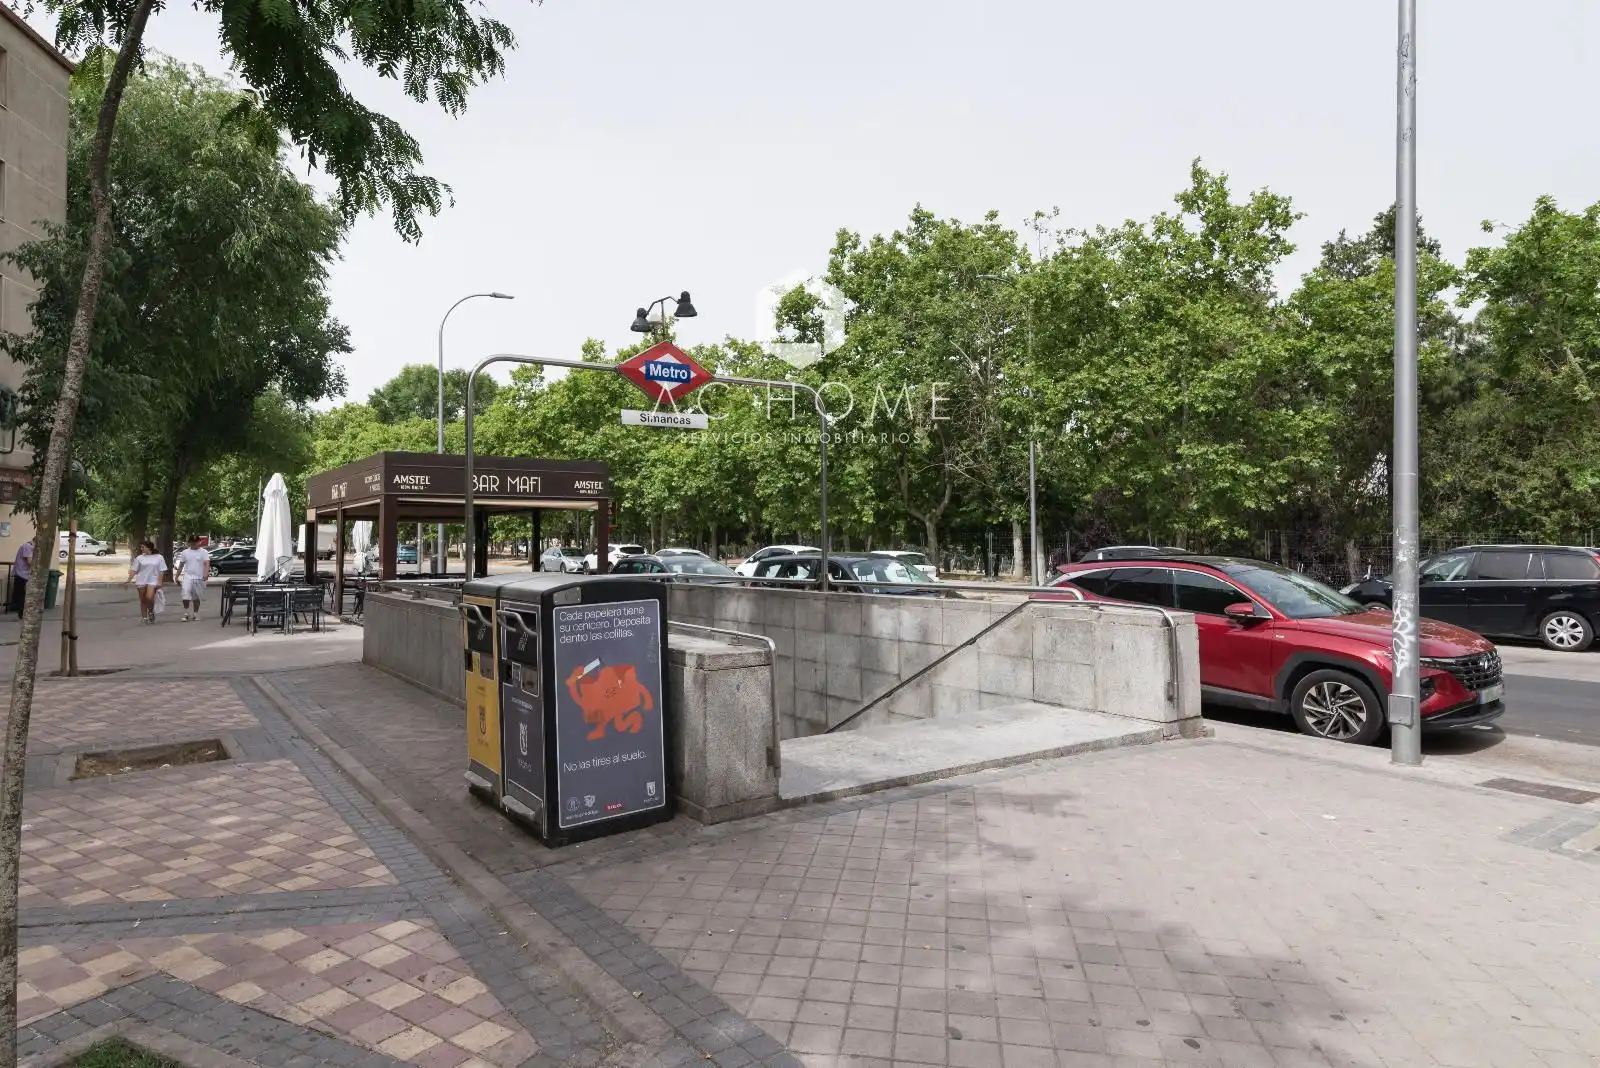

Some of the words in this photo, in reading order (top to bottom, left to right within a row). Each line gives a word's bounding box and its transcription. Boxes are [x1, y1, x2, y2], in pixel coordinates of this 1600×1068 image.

[649, 363, 688, 380] Metro
[393, 474, 431, 485] AMSTEL
[472, 475, 500, 492] BAR
[507, 475, 541, 493] MAFI
[573, 480, 604, 490] AMSTEL
[559, 610, 583, 621] Cada
[584, 607, 622, 620] papelera
[623, 606, 645, 616] tiene
[559, 624, 571, 633] su
[613, 616, 651, 629] Deposita
[589, 631, 603, 642] las
[603, 628, 634, 640] colillas.
[563, 762, 578, 773] No
[578, 760, 591, 770] las
[592, 756, 611, 767] tires
[612, 753, 621, 764] al
[621, 749, 647, 762] suelo.
